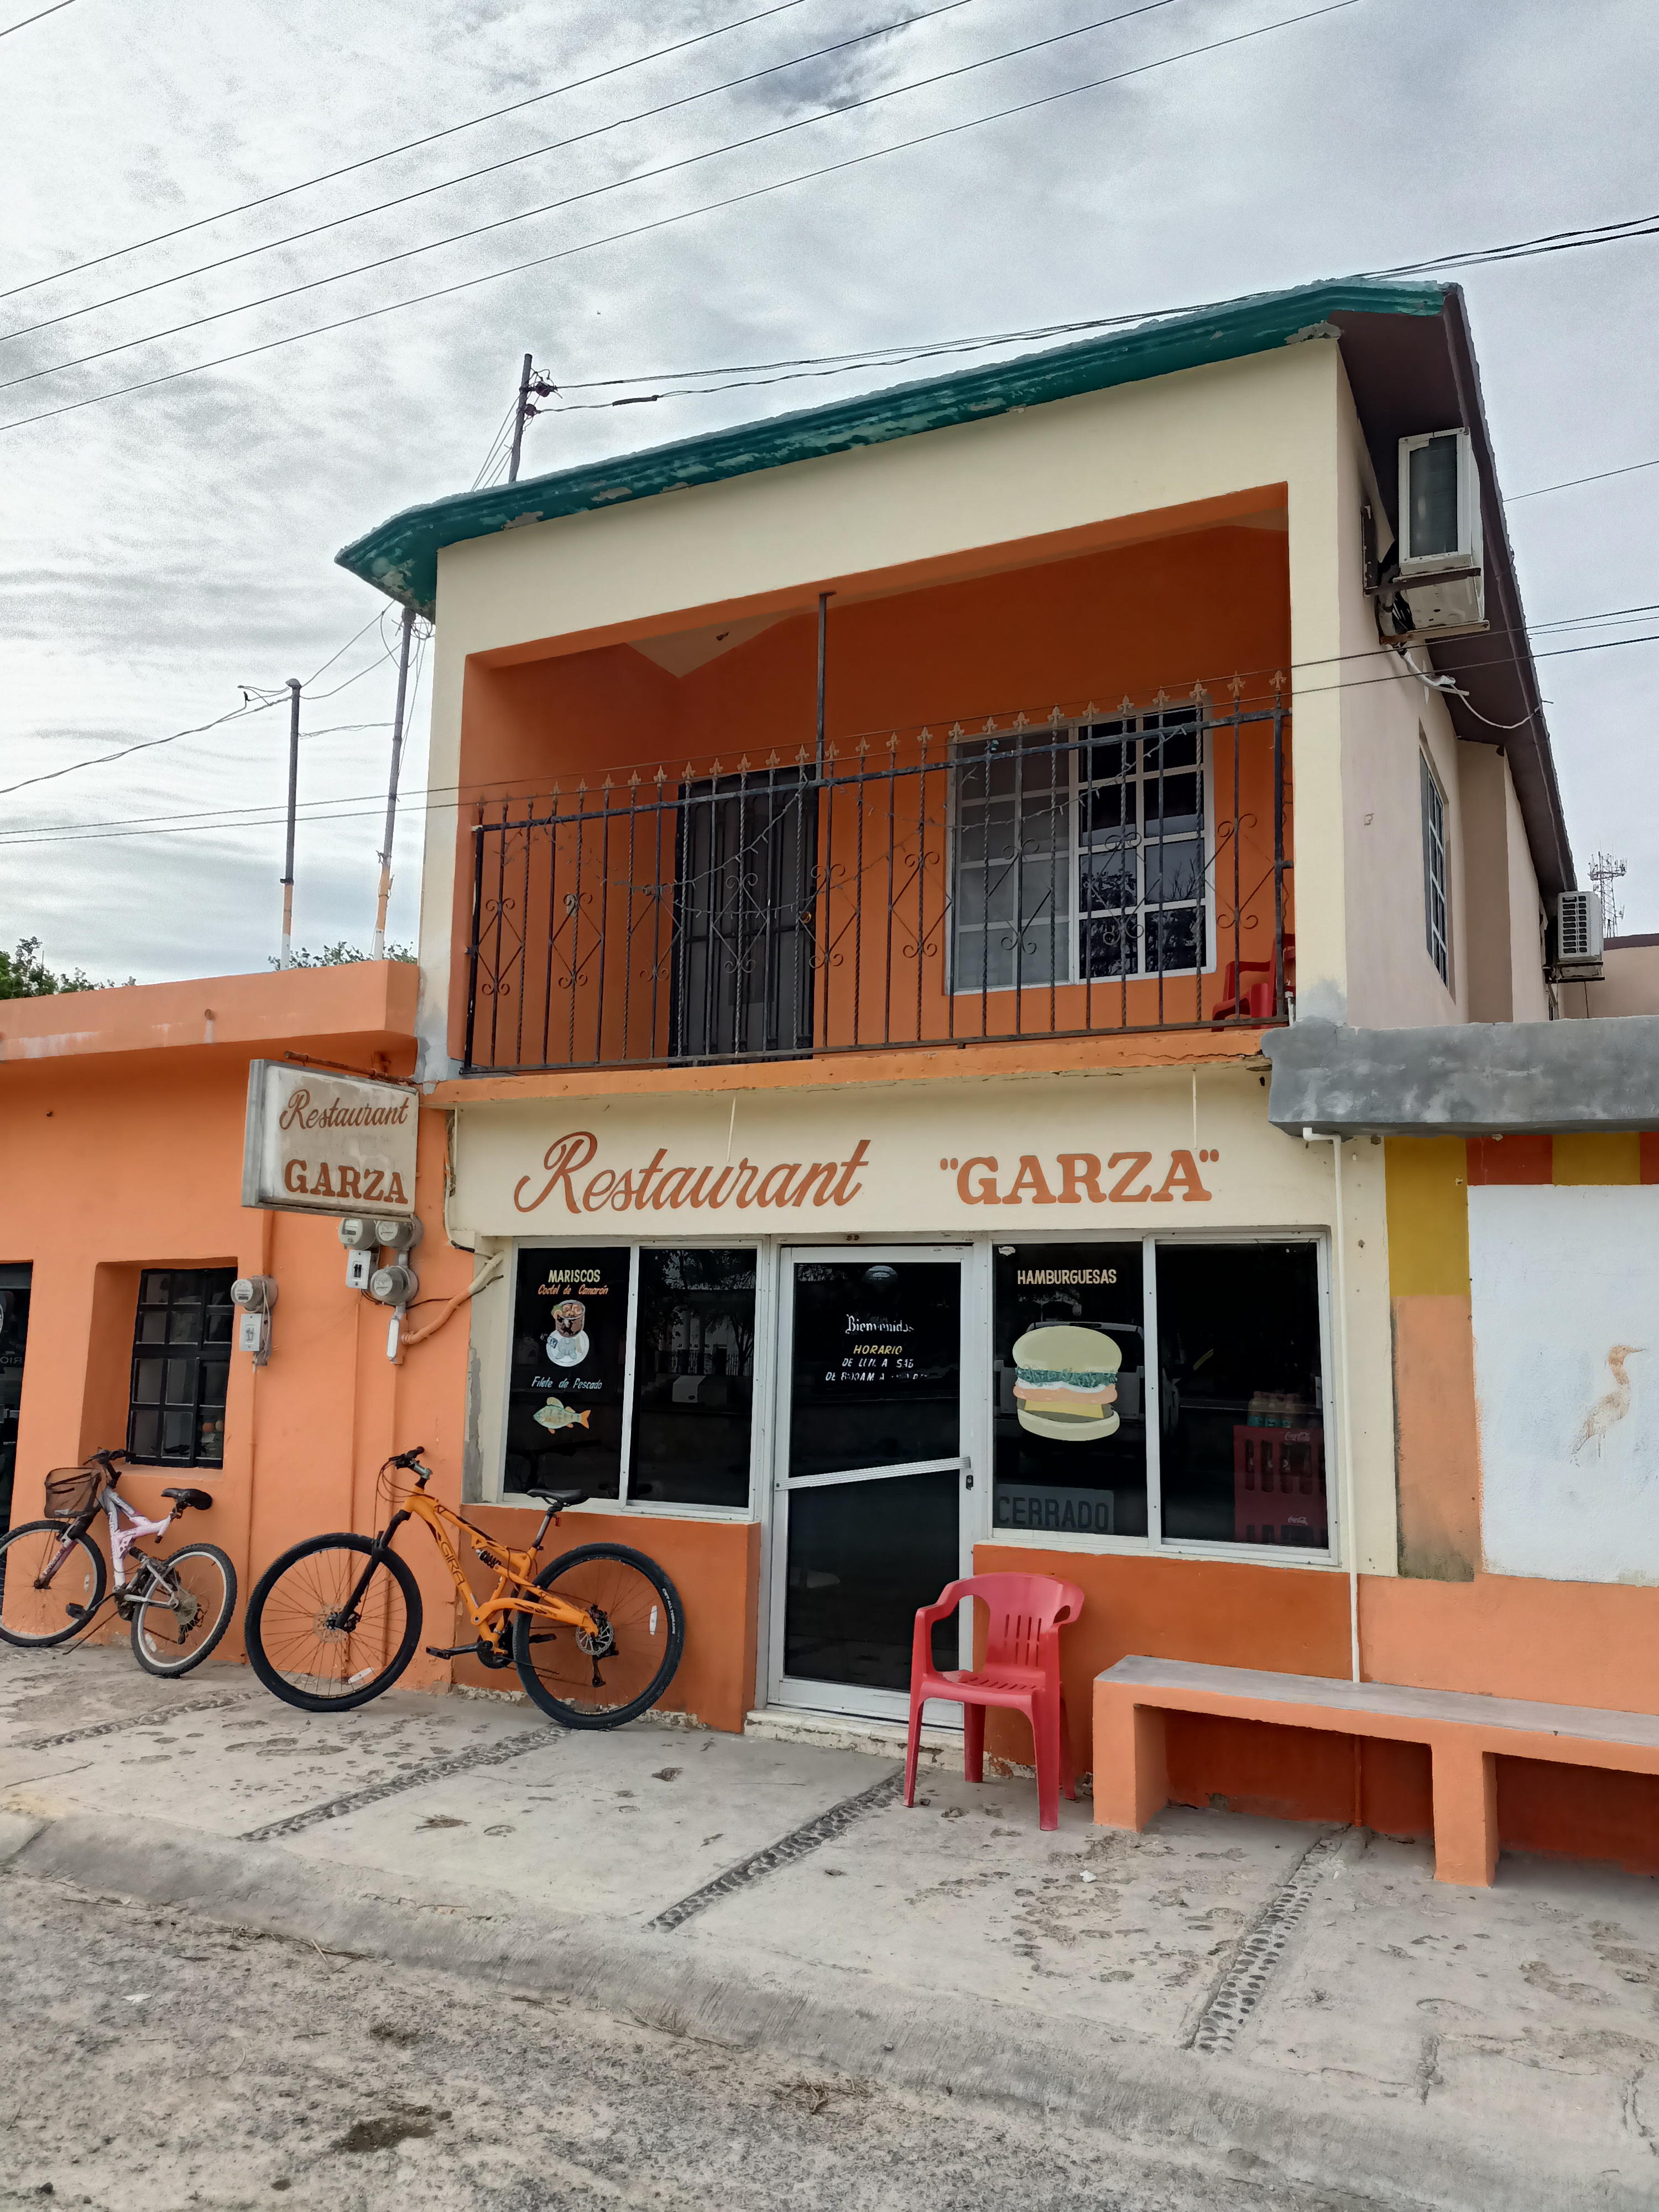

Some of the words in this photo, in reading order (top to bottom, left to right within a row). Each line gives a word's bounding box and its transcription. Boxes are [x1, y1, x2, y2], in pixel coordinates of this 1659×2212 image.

[279, 1089, 409, 1130] Restaurant
[513, 1131, 872, 1214] Restaurant
[940, 1149, 1219, 1205] "GARZA"
[284, 1159, 409, 1204] GARZA
[548, 1269, 601, 1283] MARISCOS
[1017, 1269, 1117, 1285] HAMBURGUESAS
[538, 1284, 561, 1295] Coctel
[563, 1284, 572, 1295] de
[578, 1284, 609, 1295] Camarón
[853, 1344, 902, 1355] HORARIO
[842, 1358, 854, 1367] DE
[881, 1358, 888, 1368] A
[531, 1376, 554, 1388] Filete
[558, 1378, 570, 1388] de
[572, 1378, 603, 1389] Pescado
[997, 1495, 1109, 1531] CERRADO
